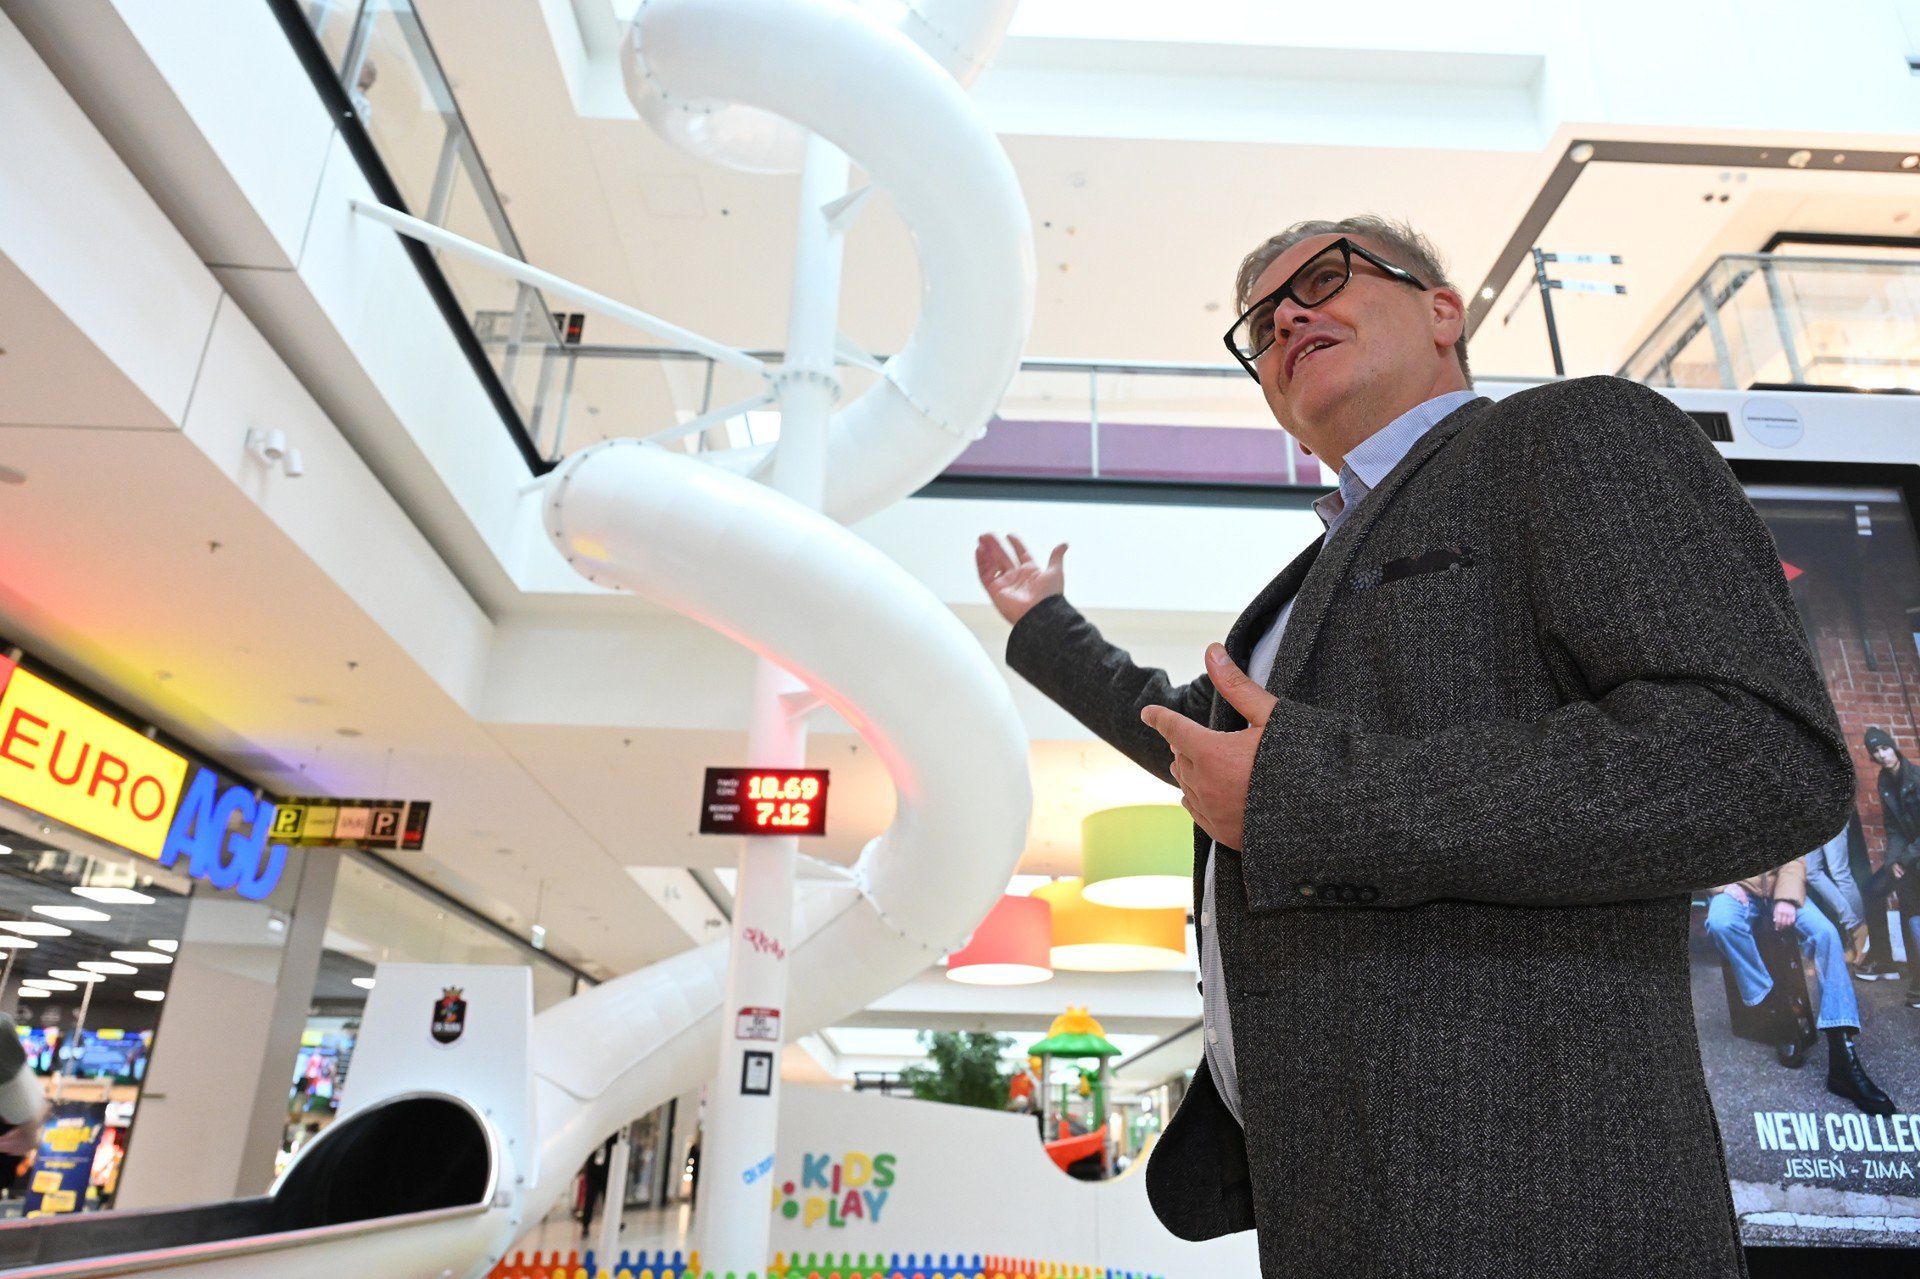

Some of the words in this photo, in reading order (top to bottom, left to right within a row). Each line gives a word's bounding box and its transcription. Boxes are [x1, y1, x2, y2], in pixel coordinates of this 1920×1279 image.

[0, 706, 165, 821] EURO
[748, 776, 819, 800] 10.69
[756, 802, 810, 826] 7.12
[1753, 1111, 1820, 1151] NEW
[802, 1150, 897, 1195] KIDS
[1783, 1154, 1847, 1179] JESIEŃ
[1862, 1159, 1915, 1179] ZIMA
[803, 1189, 889, 1228] PLAY
